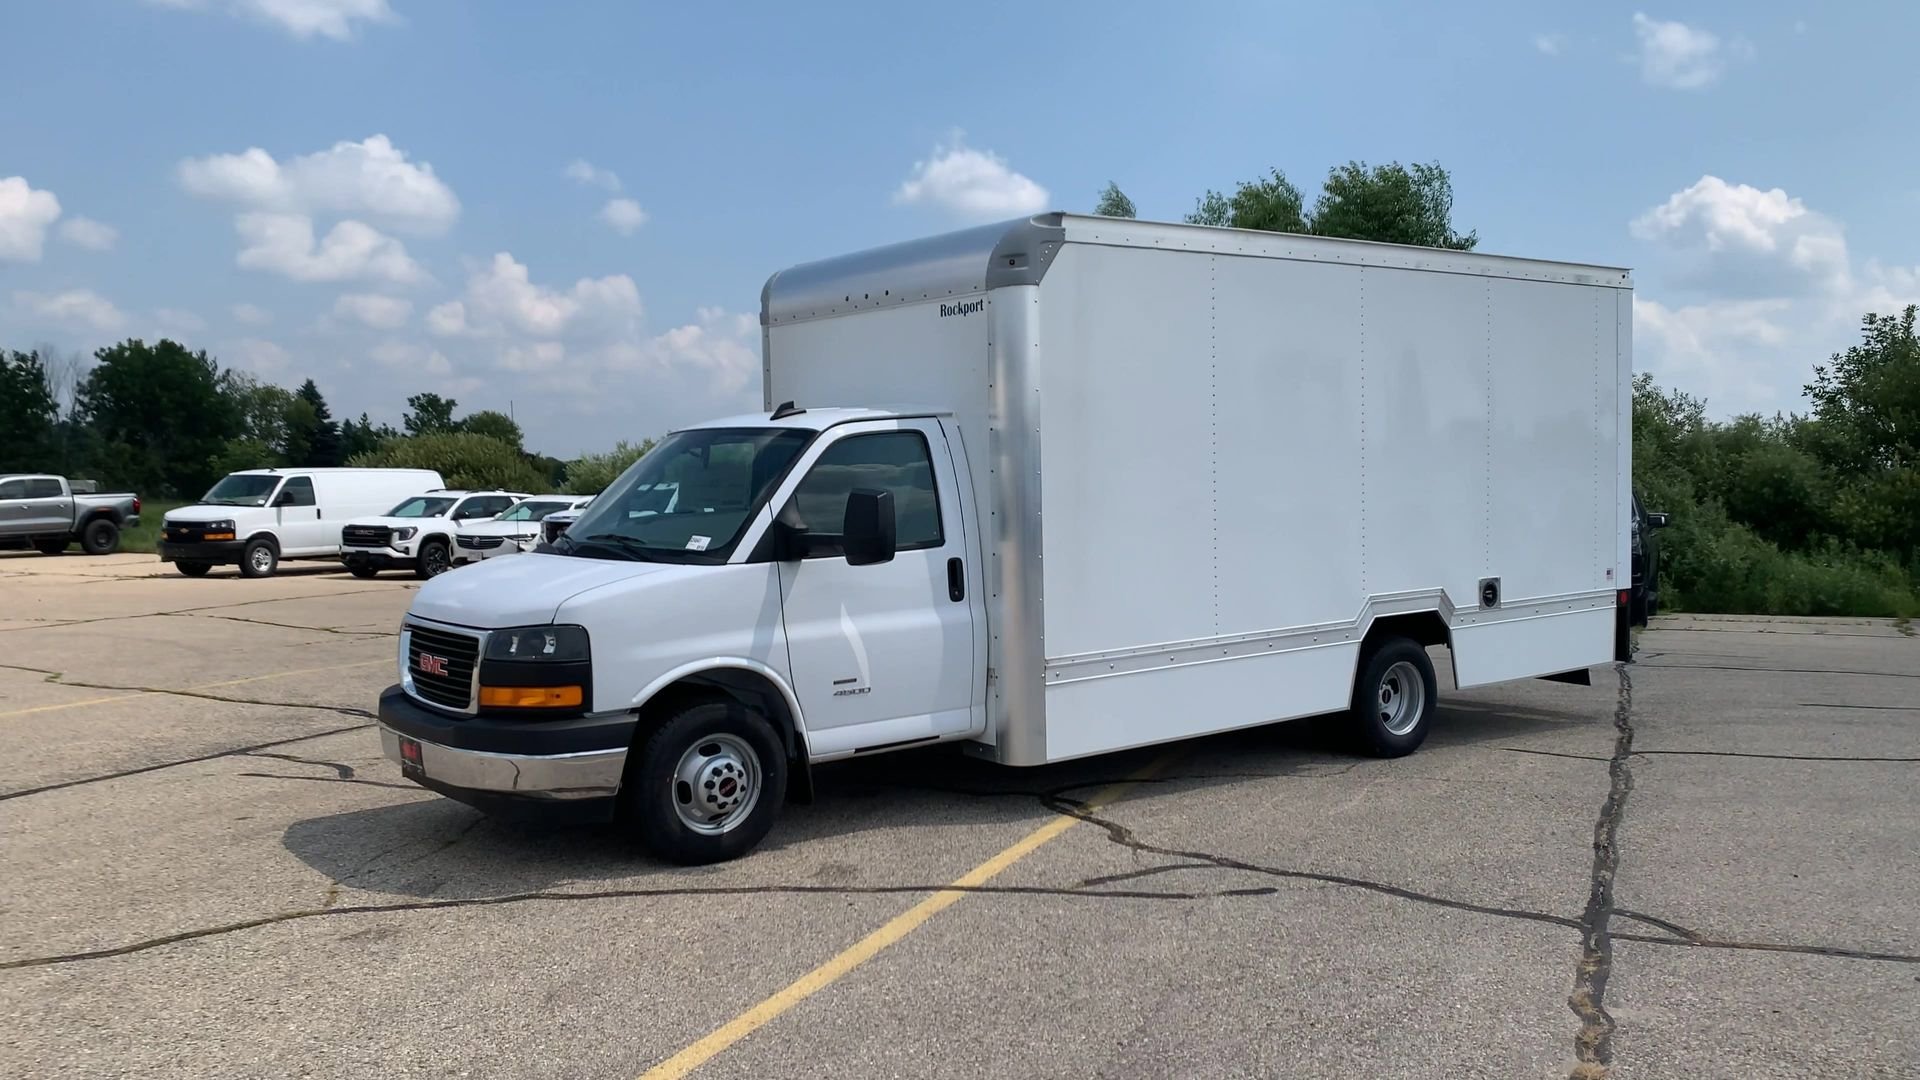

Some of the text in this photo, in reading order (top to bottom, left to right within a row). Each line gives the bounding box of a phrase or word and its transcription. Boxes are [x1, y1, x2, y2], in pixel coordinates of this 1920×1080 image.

[940, 299, 984, 317] Rockport
[420, 652, 449, 677] GMC
[833, 687, 871, 696] 4500
